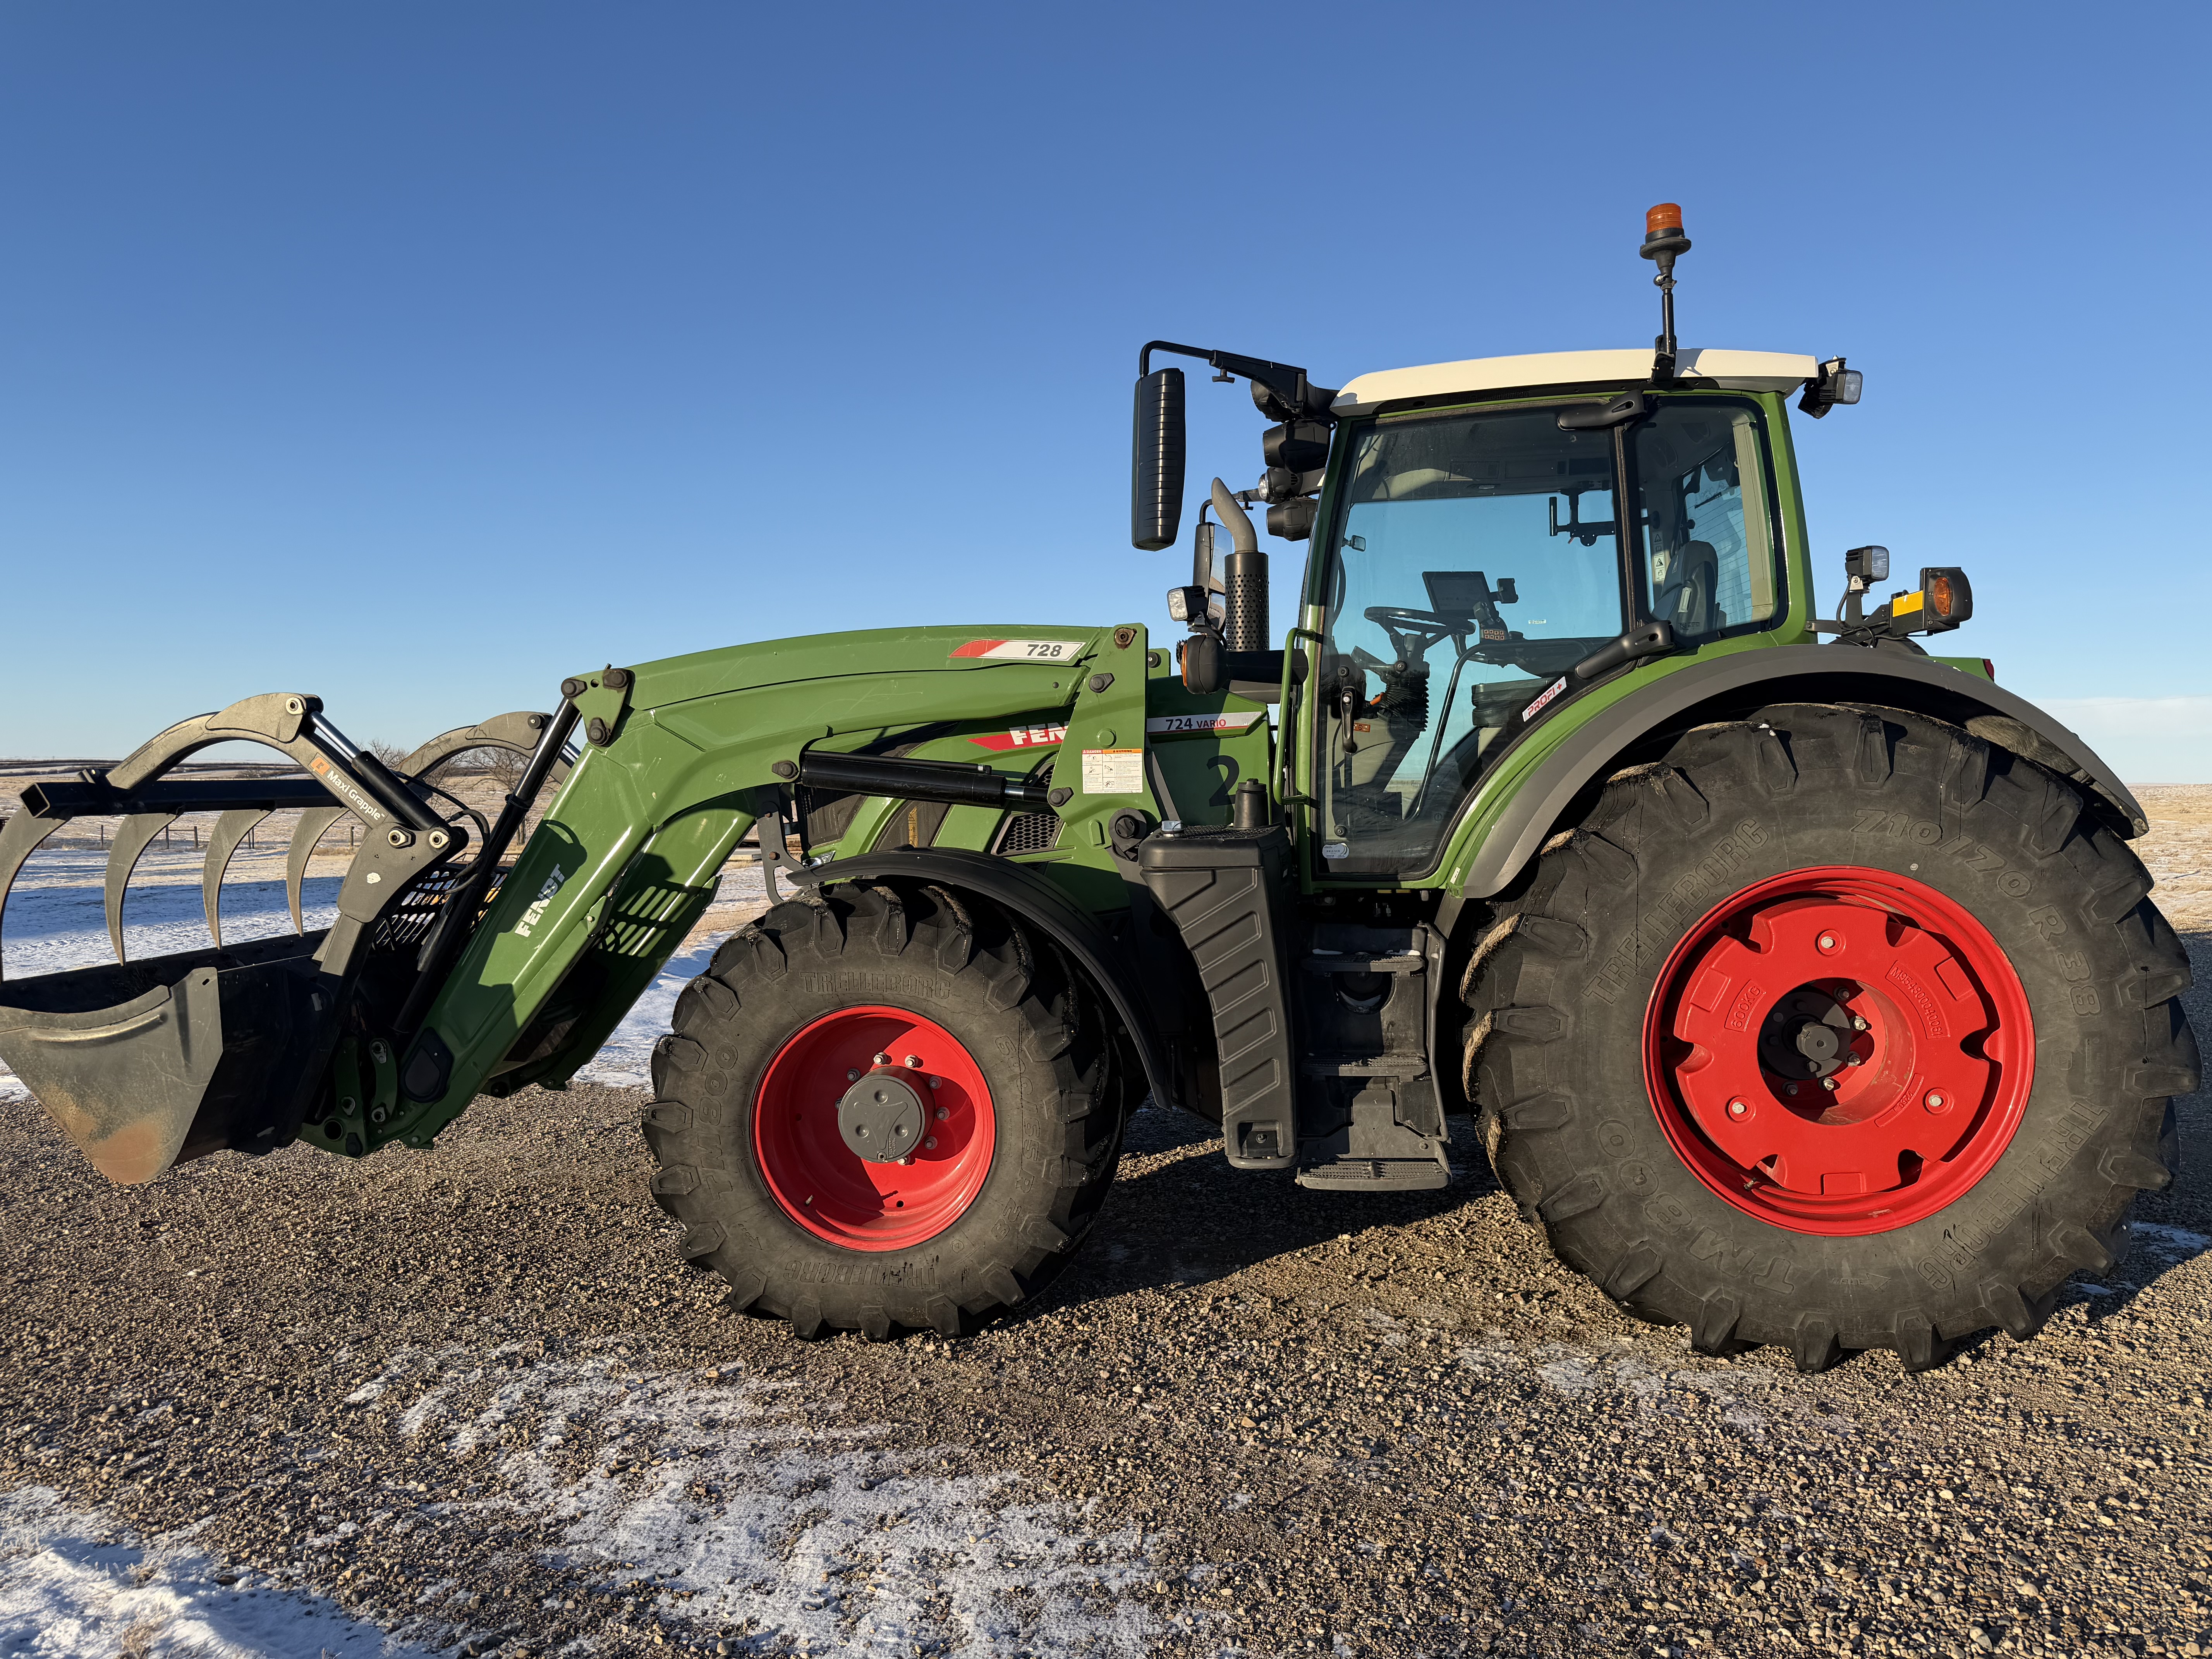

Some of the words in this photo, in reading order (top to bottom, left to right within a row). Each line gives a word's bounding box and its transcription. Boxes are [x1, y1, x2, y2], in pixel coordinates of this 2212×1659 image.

[1027, 644, 1063, 657] 728
[1166, 718, 1193, 730] 724
[1196, 719, 1226, 728] VARIO
[1527, 687, 1555, 717] PROFI
[1009, 721, 1070, 745] FEN
[327, 770, 350, 793] Maxi
[349, 789, 381, 820] Grapple
[1206, 755, 1240, 807] 2
[514, 863, 565, 937] FENDT
[1582, 818, 1769, 1005] TRELLEBORG
[1850, 808, 2032, 898] 710/70
[2029, 905, 2068, 941] R
[2057, 950, 2102, 1017] 38
[800, 972, 951, 1000] TRELLEBORG
[1731, 986, 1760, 1029] 600KG
[697, 1042, 738, 1200] TM800
[1015, 1169, 1035, 1193] R
[1917, 1101, 2111, 1290] TRELLEBORG
[991, 1198, 1022, 1242] 28
[1597, 1119, 1795, 1295] TM800
[783, 1260, 941, 1290] TRELLEBORG
